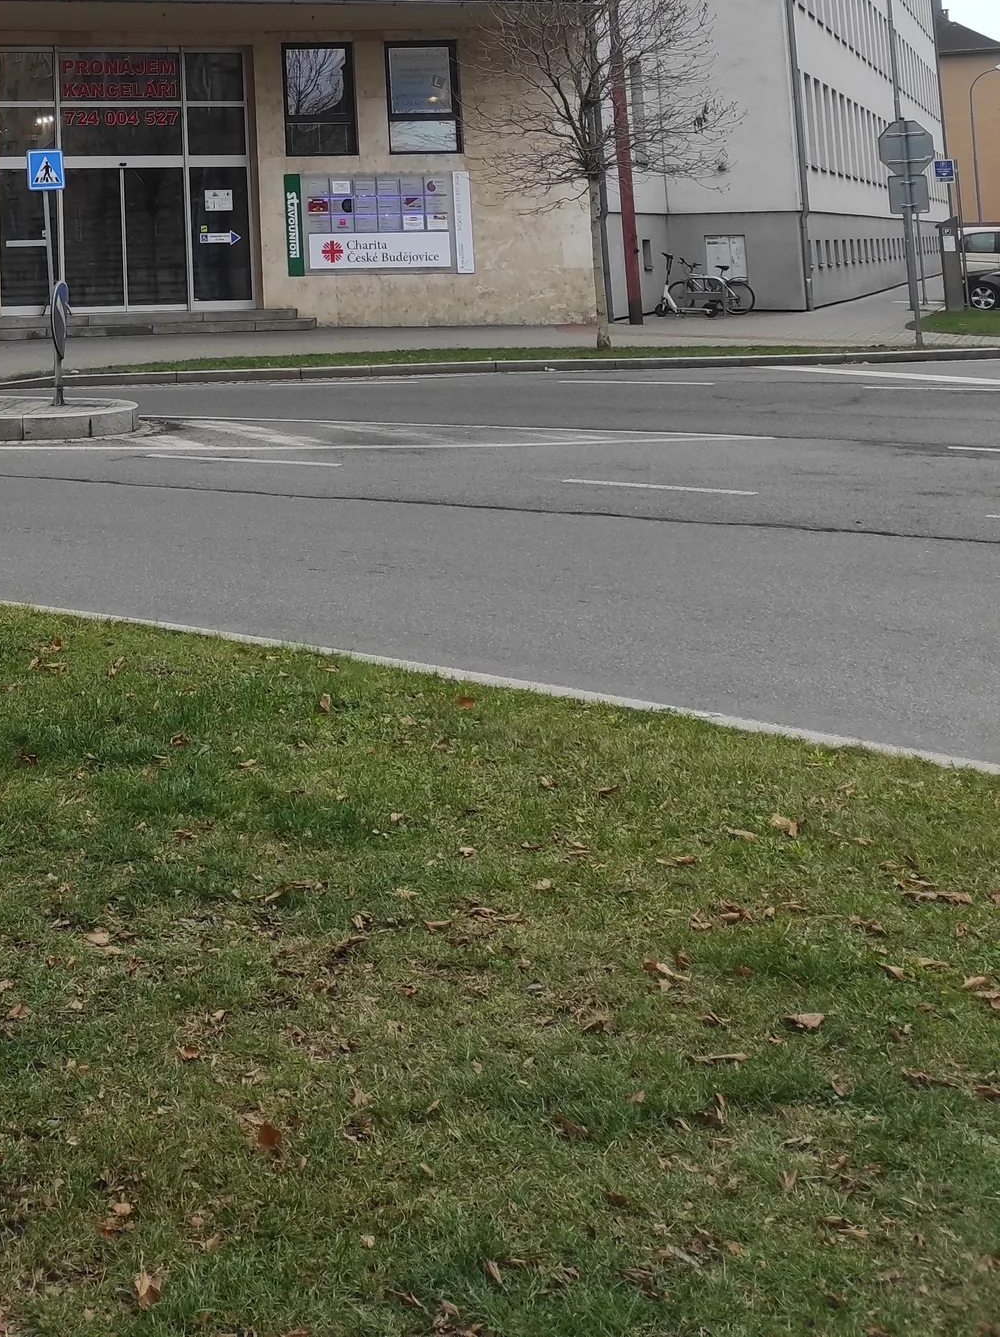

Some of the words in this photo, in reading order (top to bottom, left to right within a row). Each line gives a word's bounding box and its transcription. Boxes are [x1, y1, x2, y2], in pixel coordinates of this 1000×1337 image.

[62, 56, 176, 76] PRONÁJEM
[62, 78, 177, 98] KANCELÁŘÍ
[64, 111, 99, 126] 724
[105, 111, 139, 126] 004
[144, 110, 178, 126] 527
[346, 239, 387, 250] Charita
[347, 250, 378, 263] České
[381, 251, 440, 265] Budějovice
